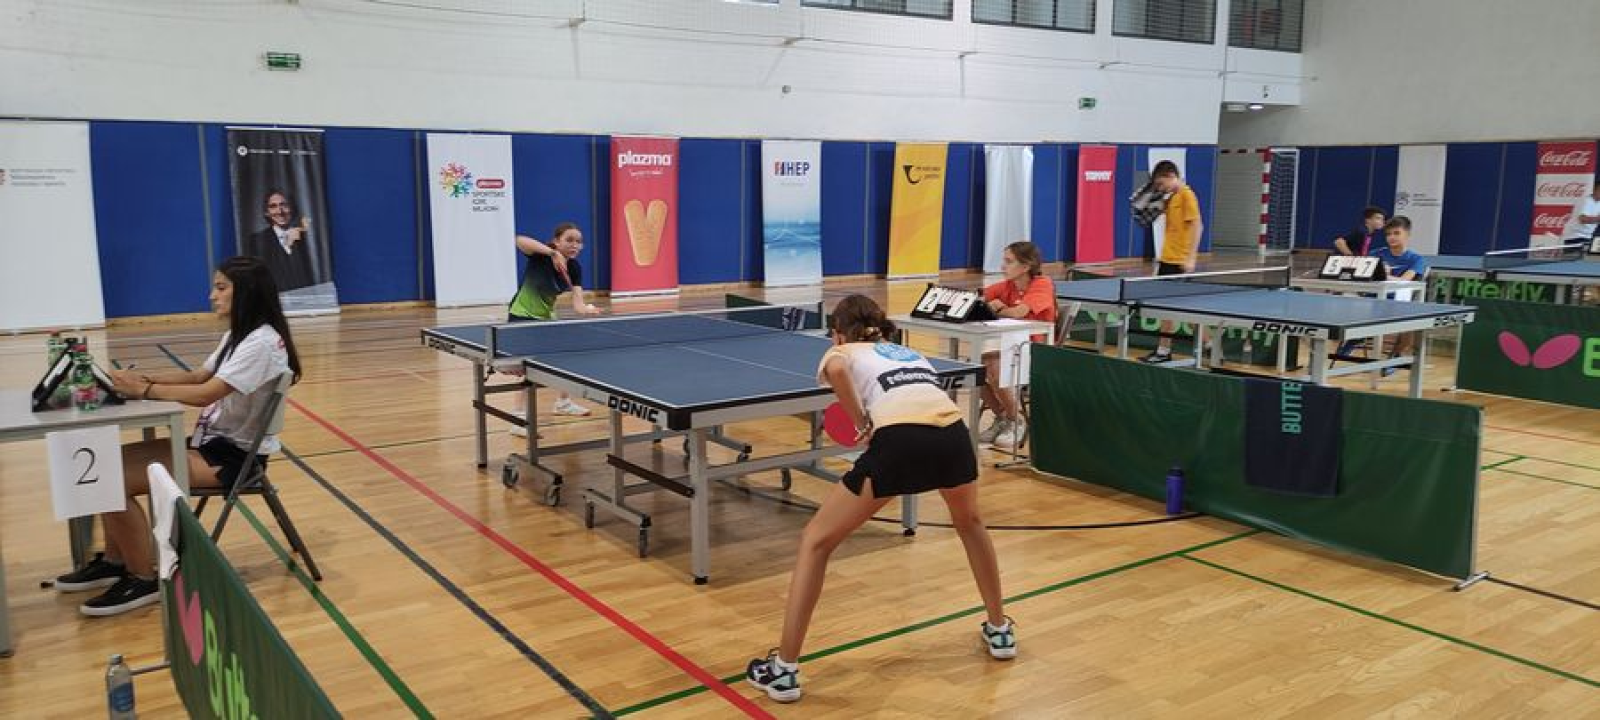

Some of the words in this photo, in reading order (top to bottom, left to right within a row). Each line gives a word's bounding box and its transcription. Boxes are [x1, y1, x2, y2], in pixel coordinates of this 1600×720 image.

[618, 150, 671, 168] plazma
[1540, 151, 1594, 166] Coca-Cola
[787, 161, 810, 176] HEP
[1538, 182, 1587, 197] Coca-Cola
[1252, 321, 1319, 337] DONIC
[608, 395, 659, 423] DONIC
[73, 447, 99, 485] 2
